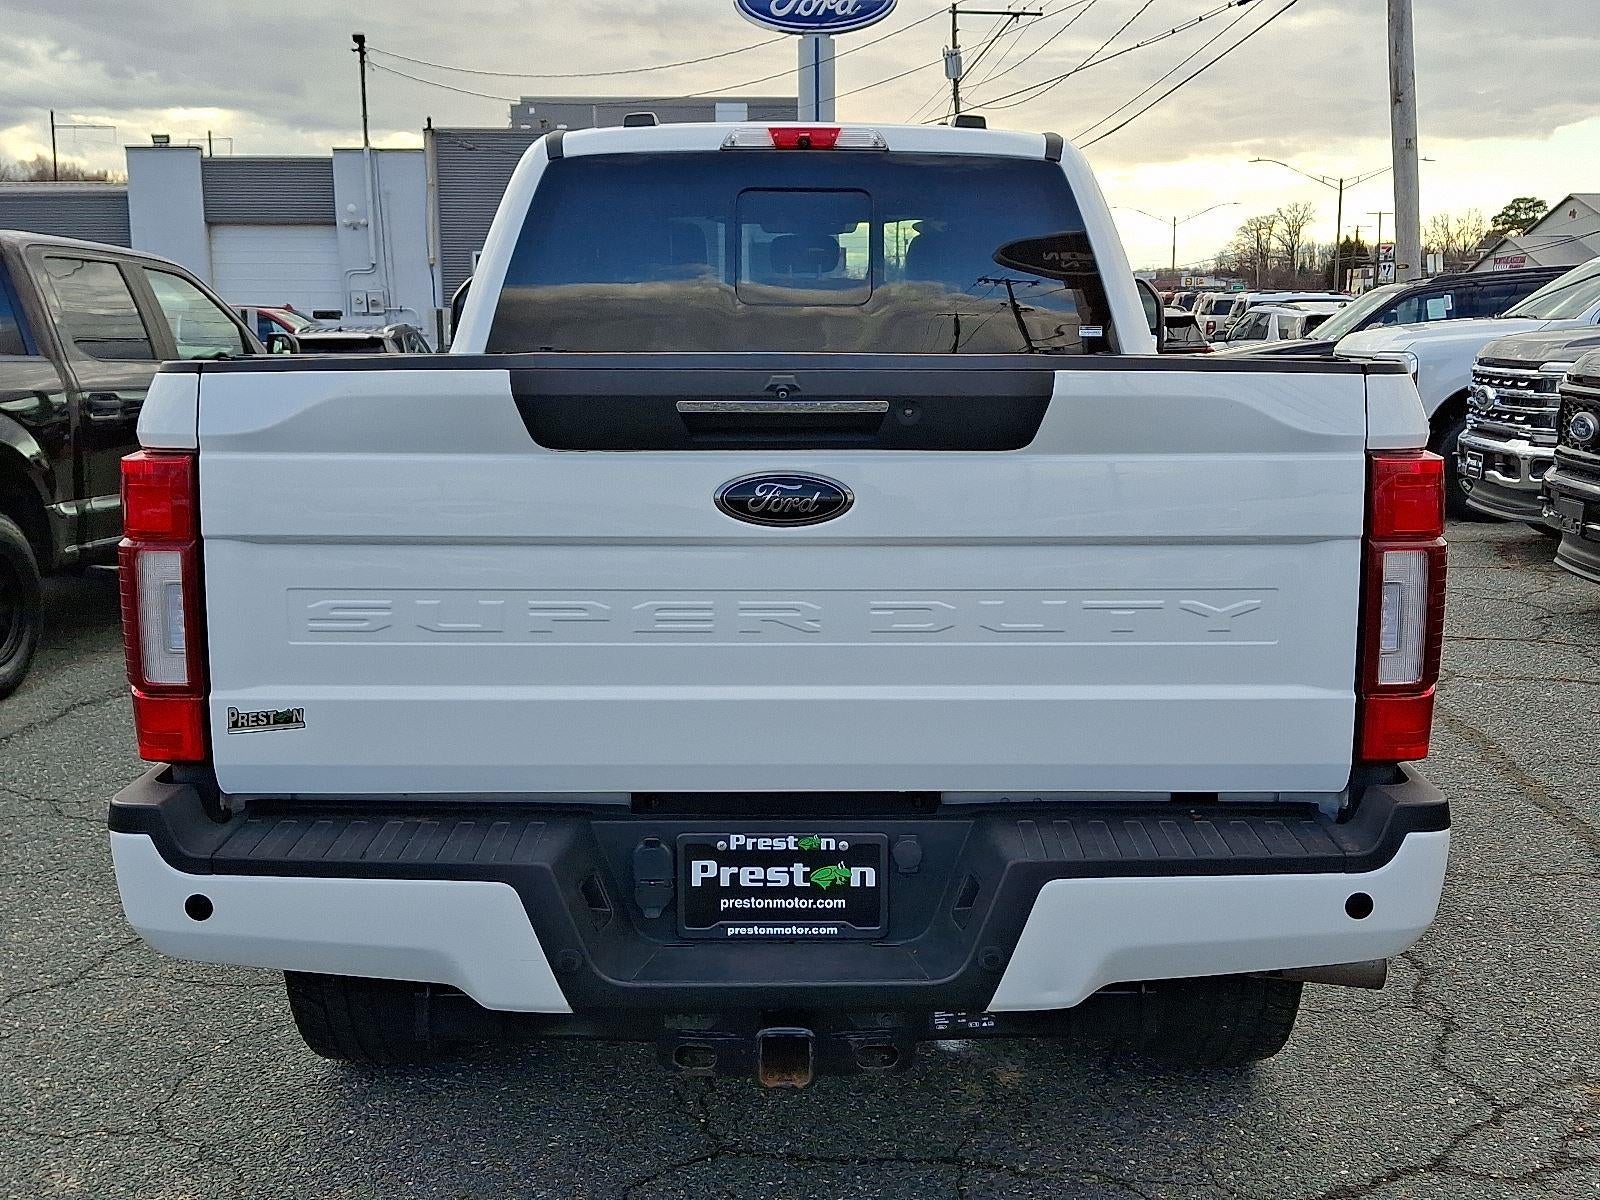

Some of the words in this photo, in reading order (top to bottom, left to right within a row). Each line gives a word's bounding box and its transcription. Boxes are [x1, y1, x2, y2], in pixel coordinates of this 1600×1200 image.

[747, 482, 821, 513] Ford
[307, 600, 821, 633] SUPER
[869, 600, 1262, 633] DUTY
[720, 896, 846, 911] prestonmotor.com
[727, 925, 838, 936] prestonmotor.com
